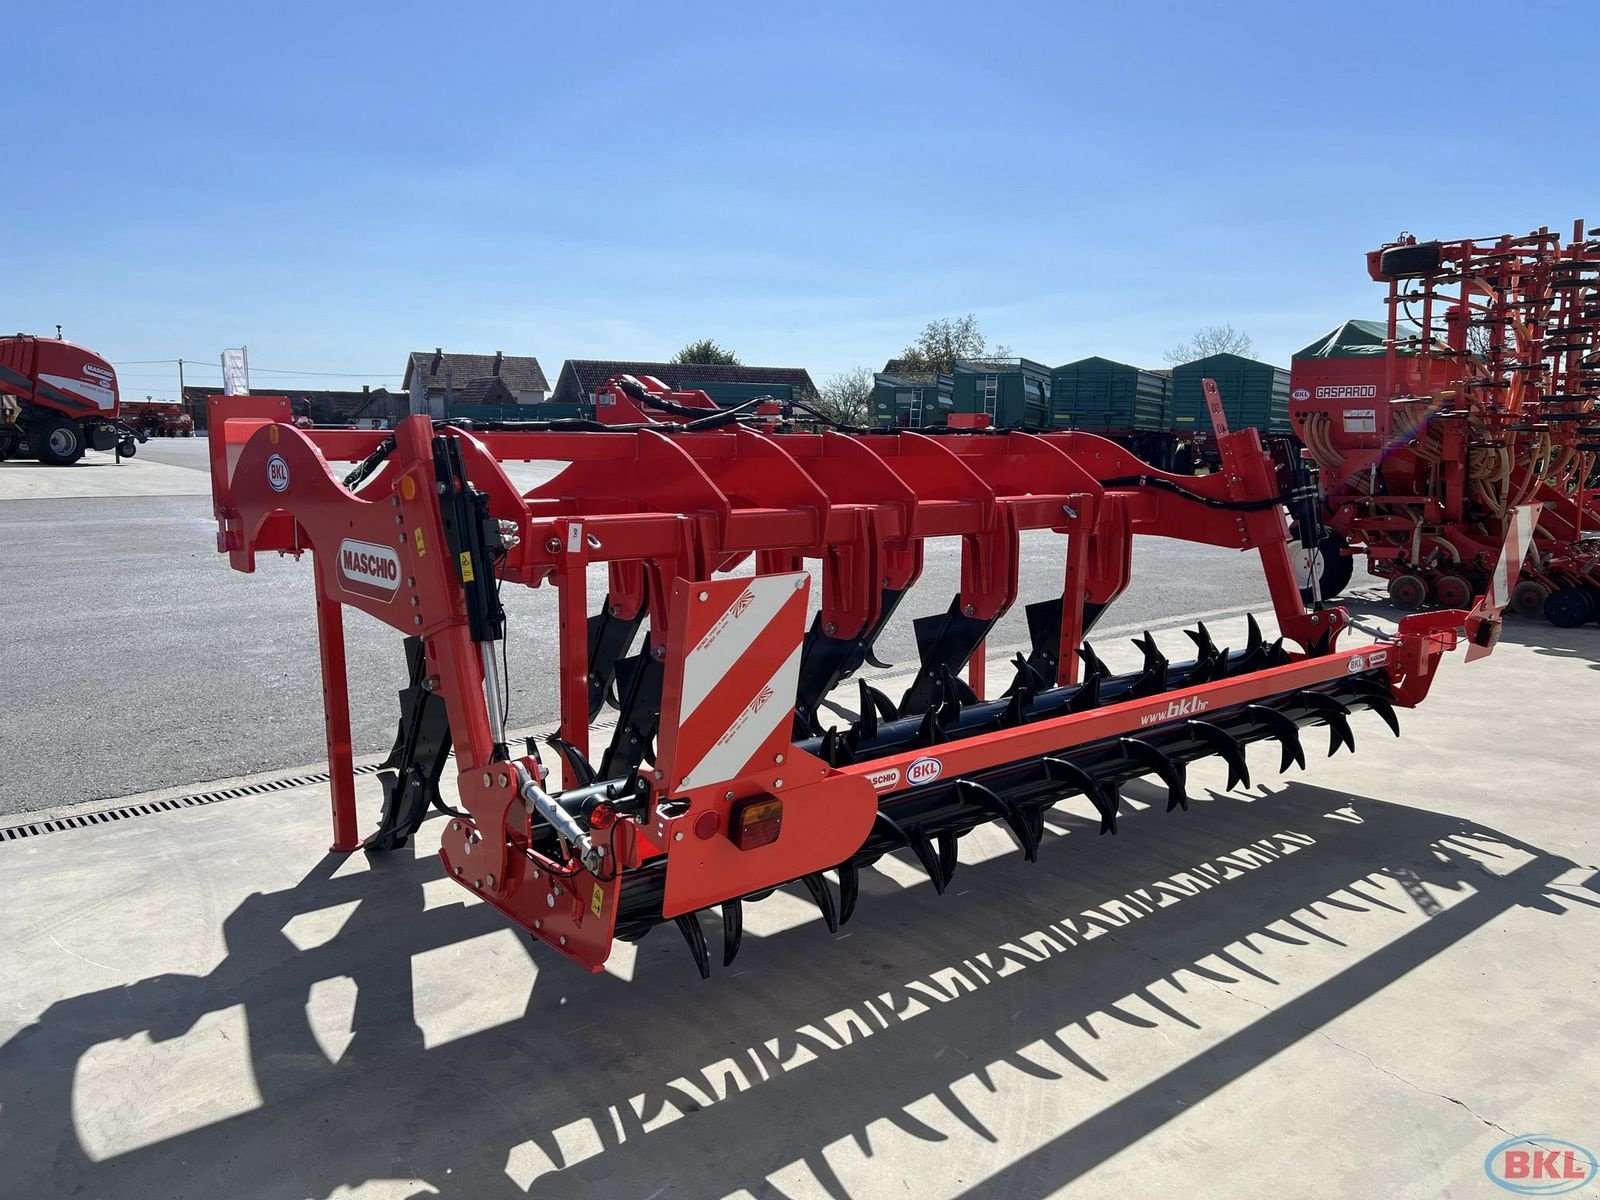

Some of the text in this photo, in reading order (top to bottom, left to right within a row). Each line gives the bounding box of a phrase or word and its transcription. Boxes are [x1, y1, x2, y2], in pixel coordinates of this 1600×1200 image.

[1316, 386, 1375, 398] GASPARDO
[271, 464, 286, 480] BKL
[343, 550, 397, 581] MASCHIO
[1350, 658, 1361, 669] BKL
[913, 763, 937, 779] BKL
[872, 773, 896, 785] SCHIO
